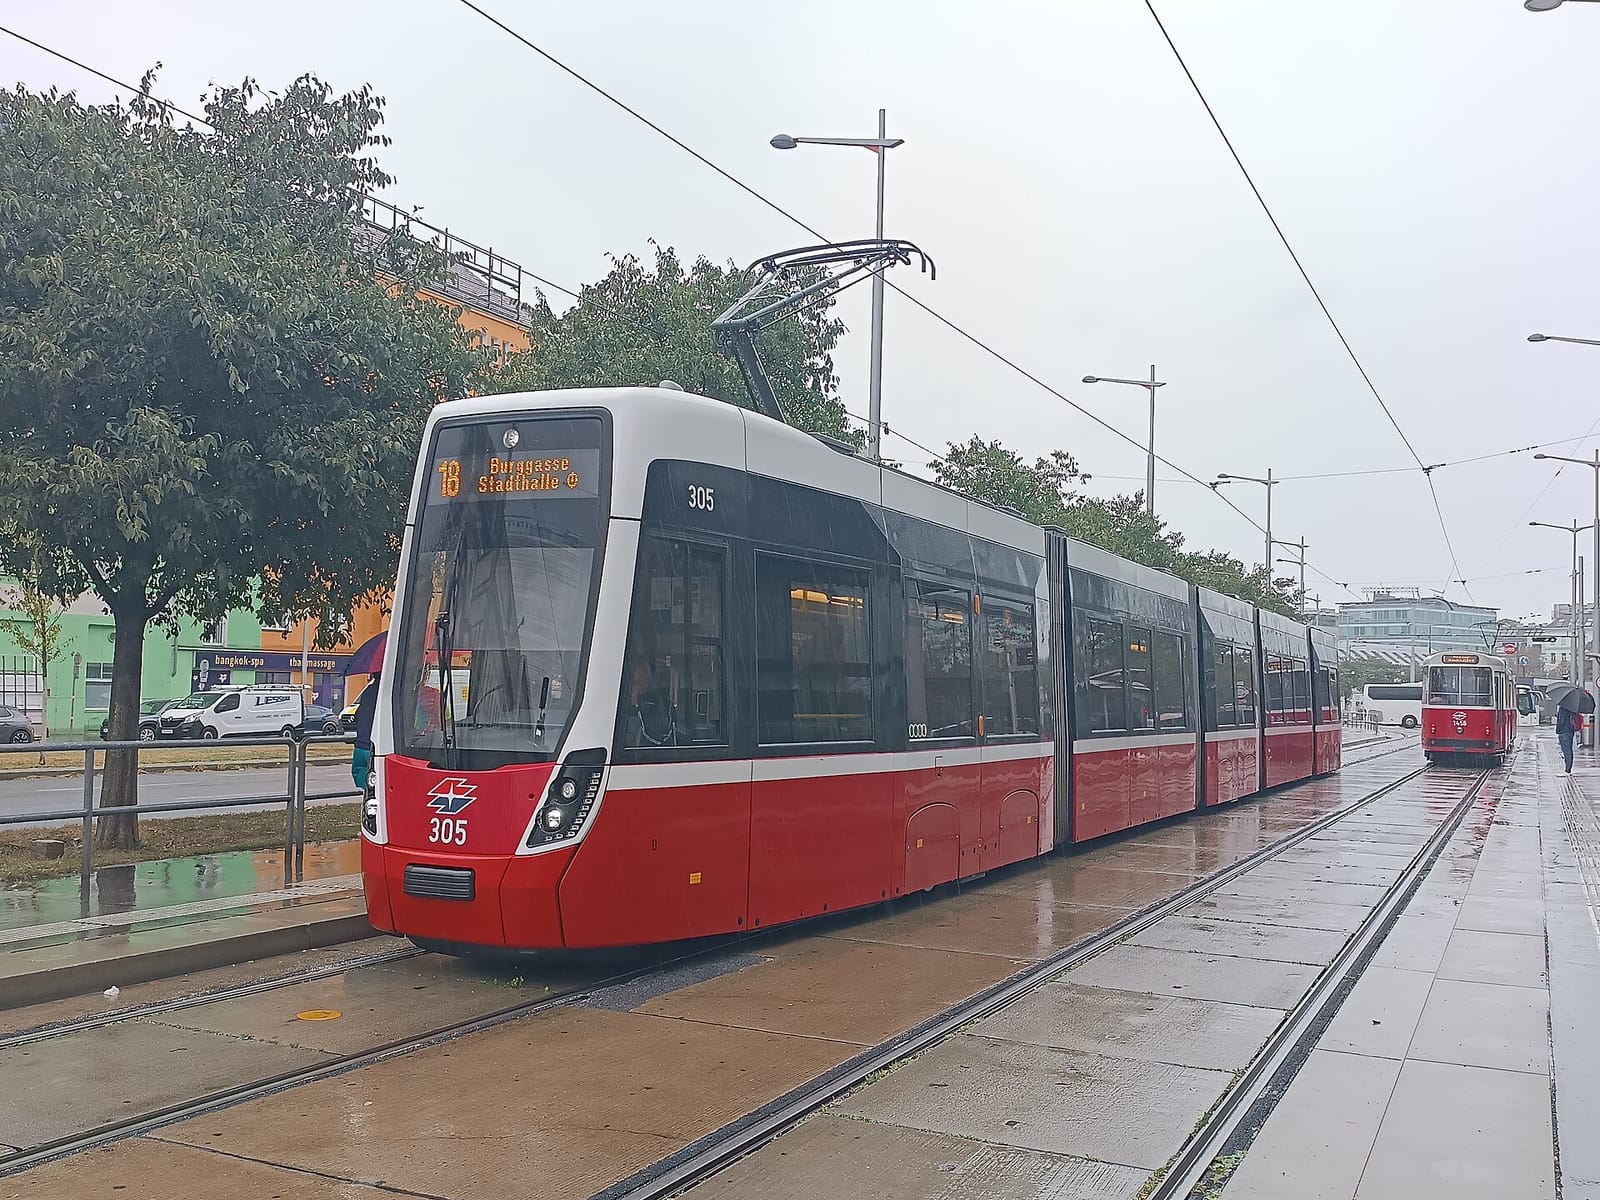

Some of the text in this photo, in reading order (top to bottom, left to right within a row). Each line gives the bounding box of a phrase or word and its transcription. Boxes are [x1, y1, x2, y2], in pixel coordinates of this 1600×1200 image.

[489, 457, 570, 476] Burggasse
[437, 459, 461, 498] 18
[478, 473, 560, 493] Stadthalle
[688, 484, 714, 511] 305
[215, 654, 264, 668] bangkok-spa
[289, 657, 336, 670] tha massage
[428, 817, 468, 846] 305
